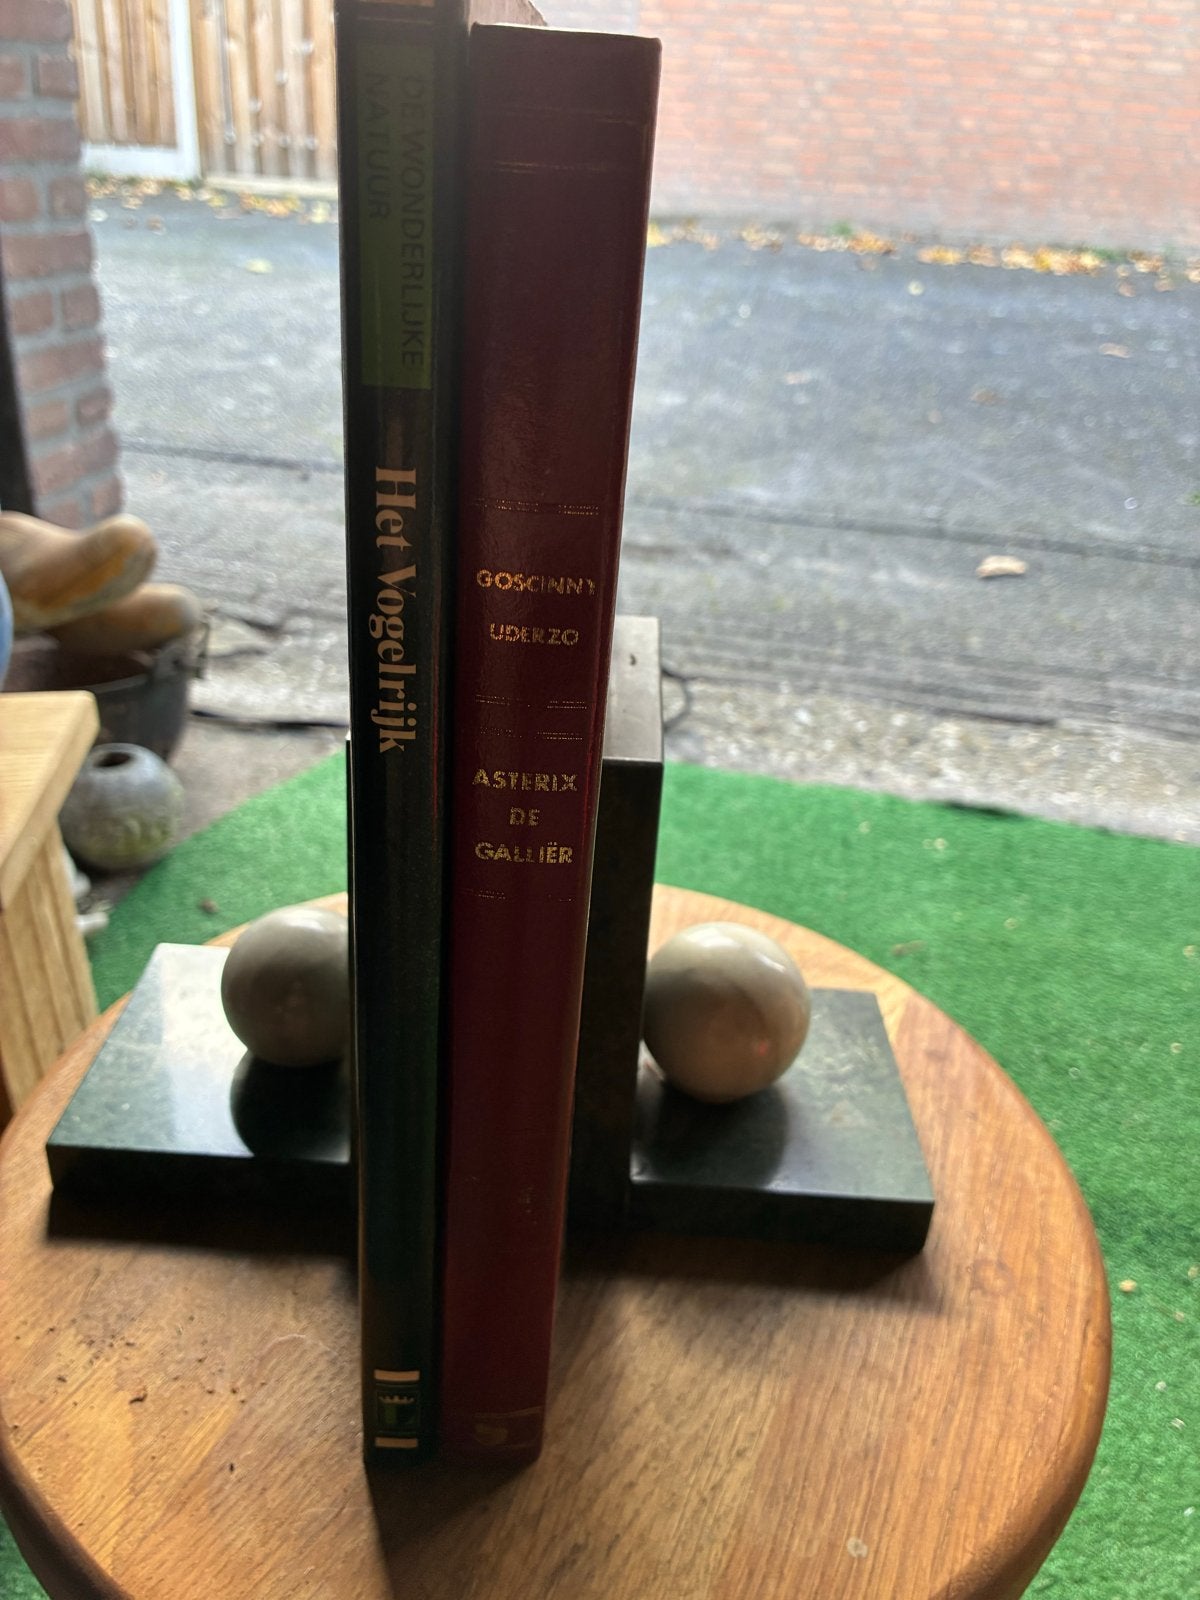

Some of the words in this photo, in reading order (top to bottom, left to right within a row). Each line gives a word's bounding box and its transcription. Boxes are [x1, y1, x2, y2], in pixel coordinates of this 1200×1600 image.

[401, 76, 425, 120] DE
[366, 73, 391, 219] NATUUR
[401, 129, 425, 366] WONDERLIJKE
[375, 467, 417, 551] Het
[490, 623, 579, 646] UDERZO
[369, 564, 417, 753] Vogelrijk
[472, 768, 578, 792] ASTERIX
[509, 806, 540, 826] DE
[475, 841, 573, 863] GALLIËR
